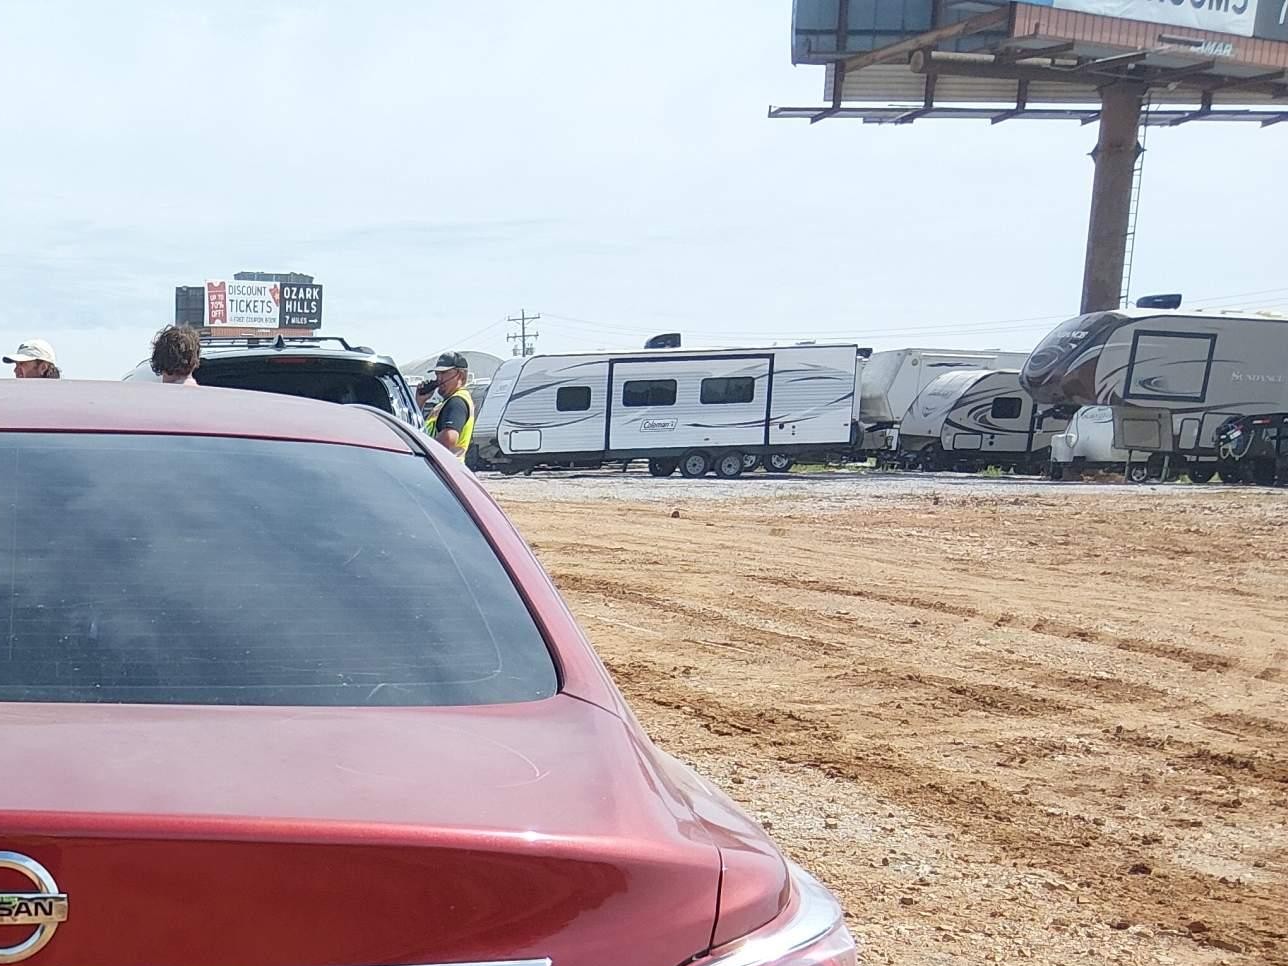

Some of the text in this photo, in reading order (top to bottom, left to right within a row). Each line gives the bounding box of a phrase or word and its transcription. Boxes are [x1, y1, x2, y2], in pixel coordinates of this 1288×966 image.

[228, 285, 267, 297] DISCOUNT
[283, 287, 320, 300] OZARK
[229, 299, 273, 313] TICKETS
[285, 300, 317, 313] HILLS
[285, 315, 308, 325] 7 MILES
